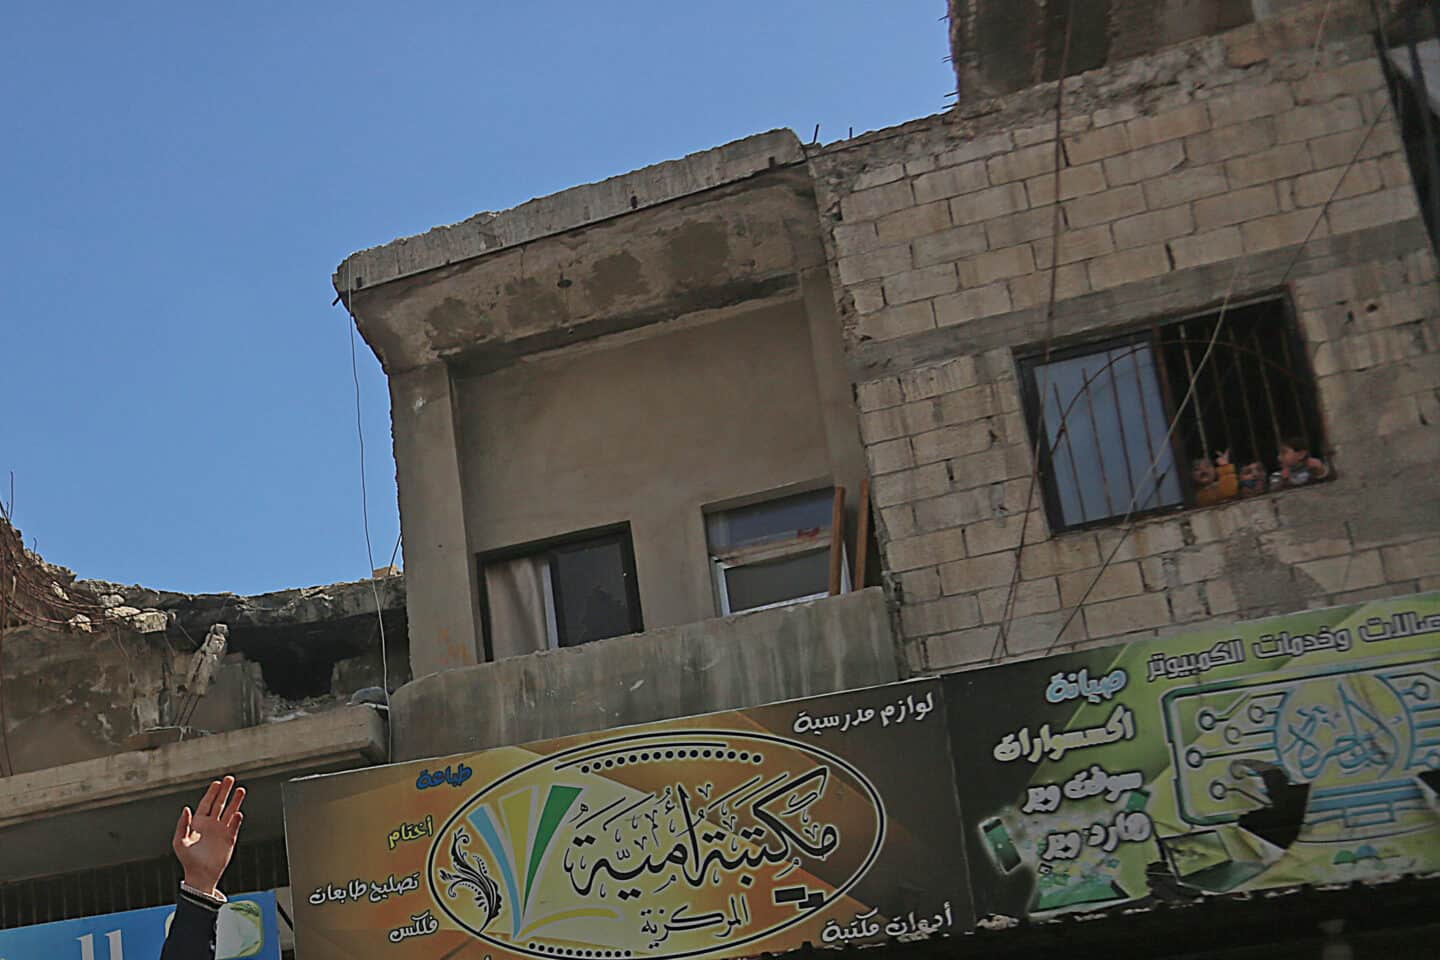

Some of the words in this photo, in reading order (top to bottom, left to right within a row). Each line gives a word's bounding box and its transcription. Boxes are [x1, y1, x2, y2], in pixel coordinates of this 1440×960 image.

[1147, 639, 1245, 681] الكمبيوتر
[1253, 626, 1352, 661] وخدمات
[1045, 668, 1128, 703] صيانة
[793, 707, 875, 734] مدرسية
[880, 692, 934, 727] لوازم
[416, 763, 472, 790] طباعة
[1063, 766, 1143, 801] سوفت
[387, 815, 433, 848] أختام
[1087, 812, 1152, 852] هارد
[309, 880, 367, 904] طابعات
[369, 873, 420, 902] تصليح
[389, 910, 439, 942] فلكس
[640, 896, 749, 949] المركزية
[822, 906, 879, 943] مكتبة
[886, 902, 953, 937] أدوات
